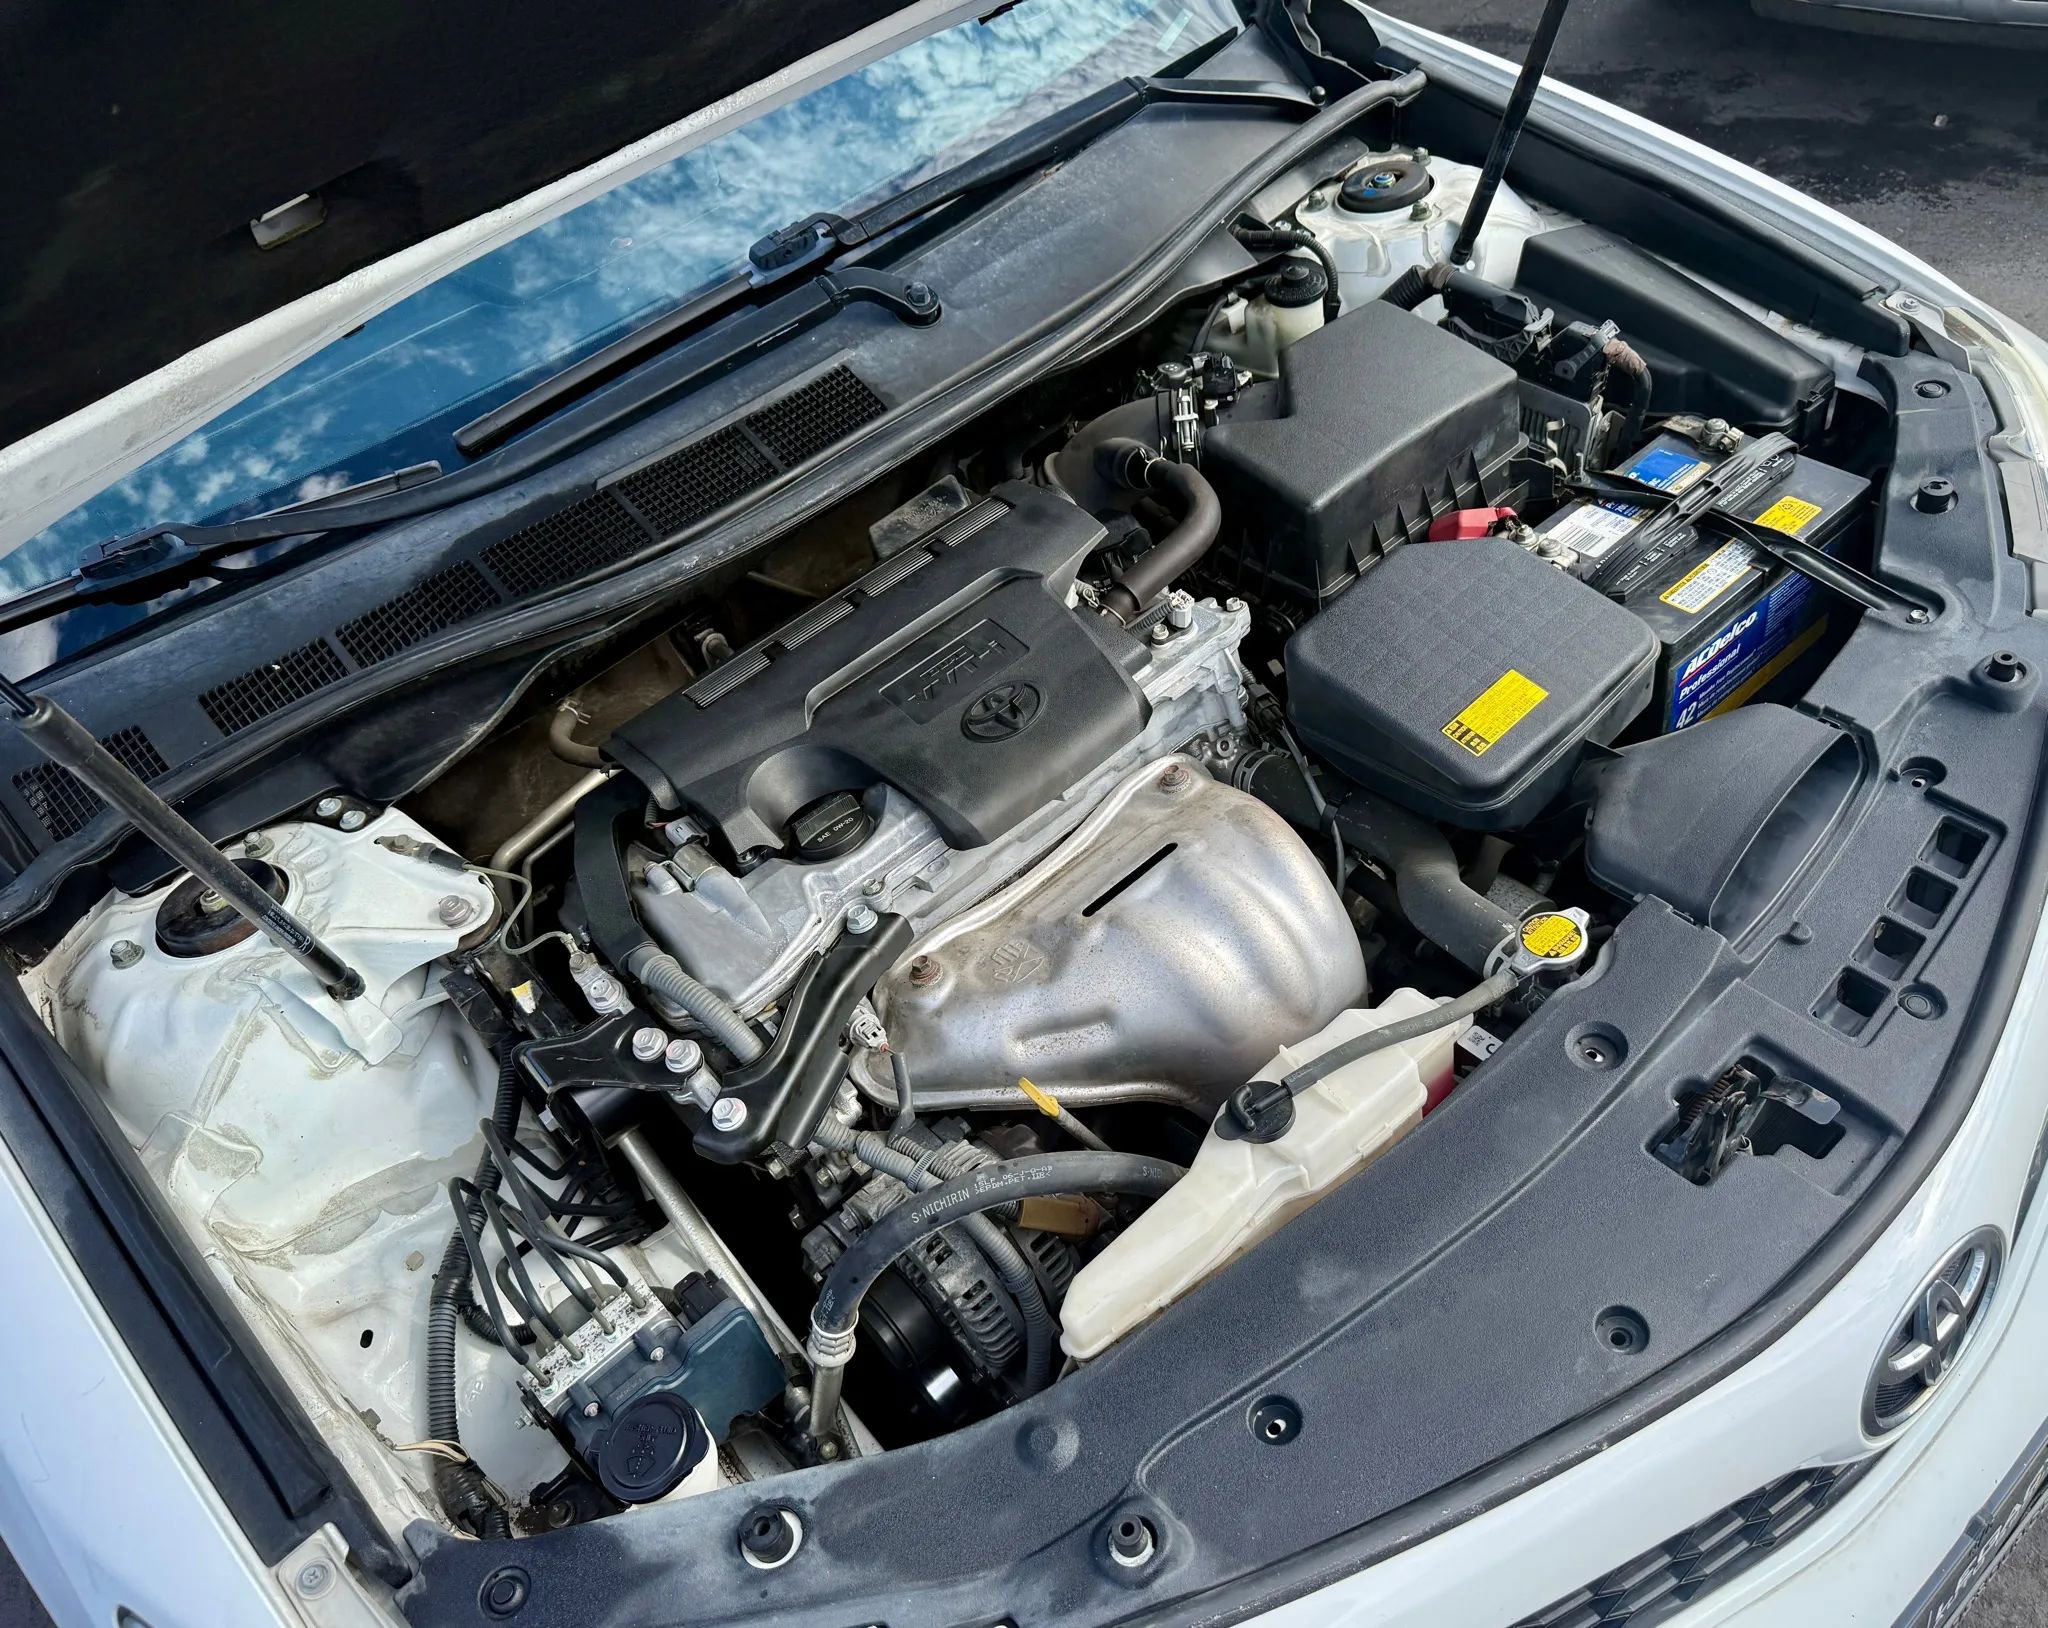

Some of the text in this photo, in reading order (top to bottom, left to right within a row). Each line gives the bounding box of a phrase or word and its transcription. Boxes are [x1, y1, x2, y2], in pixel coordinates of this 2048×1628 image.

[1682, 612, 1757, 680] ACDelco
[1679, 643, 1740, 700] Professional
[1676, 701, 1697, 729] 42
[817, 817, 854, 844] SAE 0W-20
